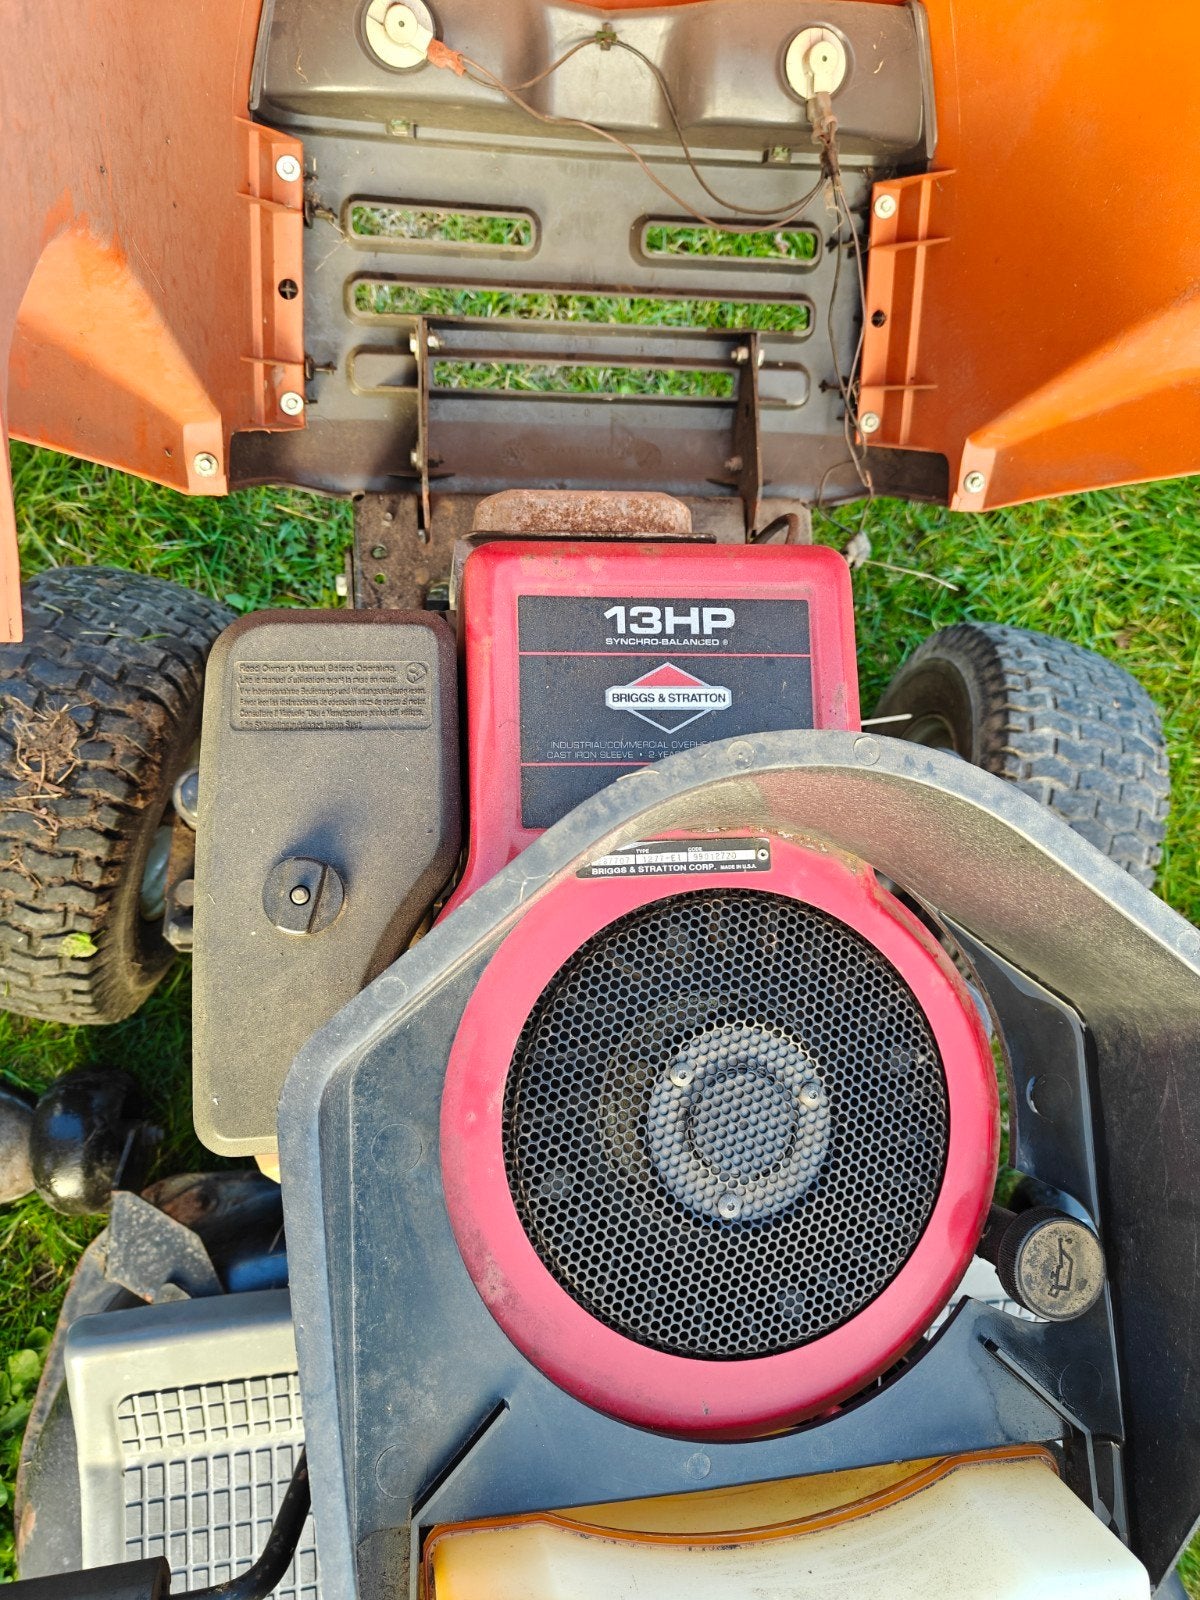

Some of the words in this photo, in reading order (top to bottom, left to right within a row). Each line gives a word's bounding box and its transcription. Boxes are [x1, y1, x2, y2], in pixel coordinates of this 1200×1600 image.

[603, 605, 735, 635] 13HP
[239, 664, 260, 673] Read
[262, 664, 295, 673] Owner's
[297, 664, 326, 673] Manual
[328, 664, 354, 673] Before
[356, 664, 397, 674] Operating.
[612, 693, 655, 703] BRIGGS
[658, 693, 666, 703] &
[668, 693, 726, 703] STRATTON
[671, 740, 711, 748] OVERH
[546, 751, 572, 759] CAST
[575, 751, 597, 759] IRON
[599, 751, 634, 759] SLEEVE
[592, 866, 627, 875] BRIGGS
[638, 864, 687, 873] STRATTON
[688, 863, 717, 871] CORP.
